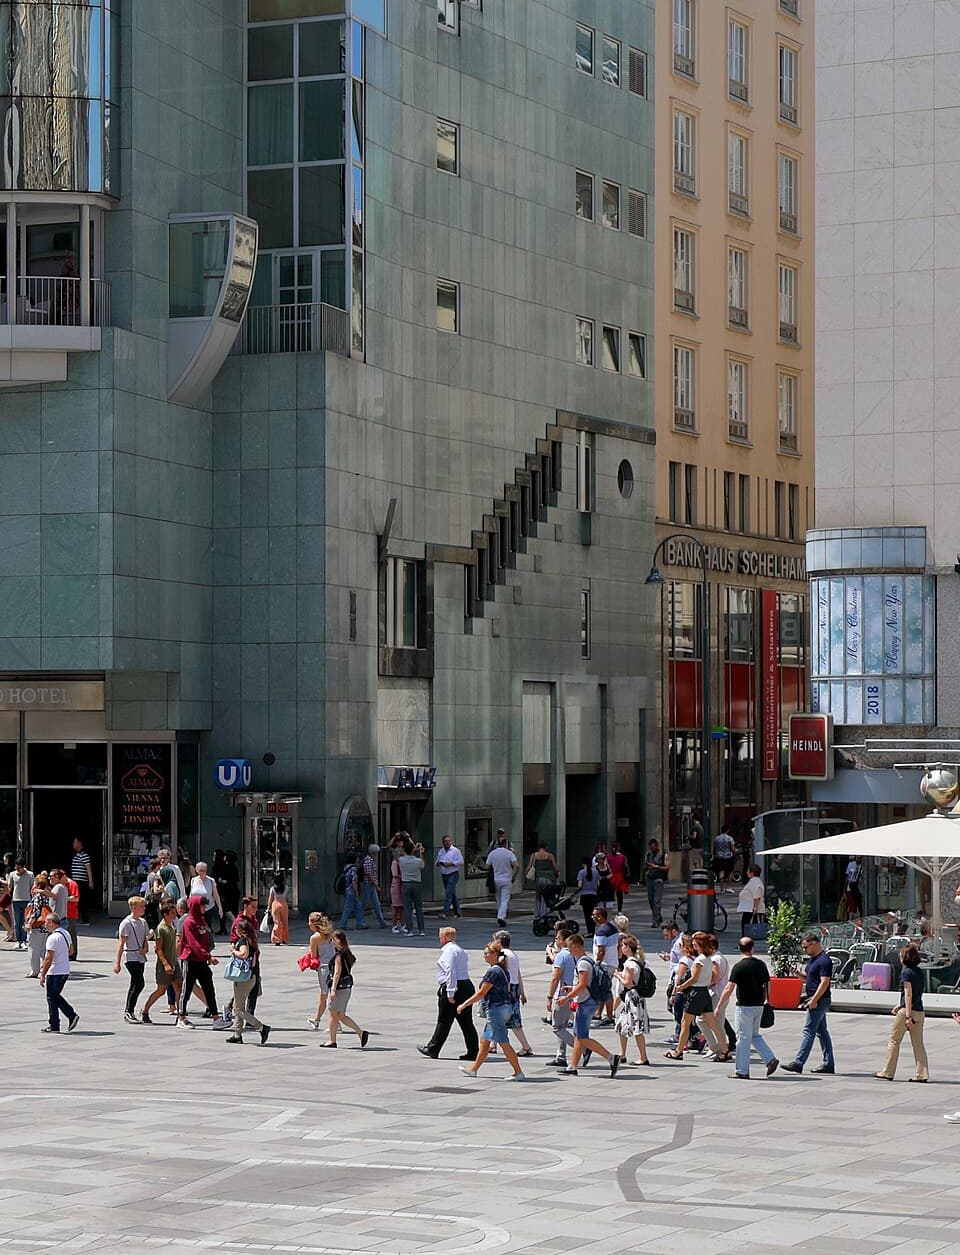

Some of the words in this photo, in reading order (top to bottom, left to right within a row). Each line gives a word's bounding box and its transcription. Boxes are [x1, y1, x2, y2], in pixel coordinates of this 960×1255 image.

[667, 541, 735, 573] BANKHAUS
[742, 550, 809, 582] SCHELHAM
[886, 585, 902, 607] Year
[886, 613, 898, 633] New
[846, 631, 861, 664] Merry
[886, 636, 901, 669] Happy
[8, 688, 71, 704] HOTEL
[867, 686, 879, 715] 2018
[793, 740, 823, 752] HEINDL
[128, 778, 158, 787] ALMAZ
[218, 765, 237, 786] U
[243, 765, 252, 786] U
[126, 794, 160, 802] VIENNA
[122, 804, 162, 813] MOSCOW
[123, 815, 161, 824] LONDON
